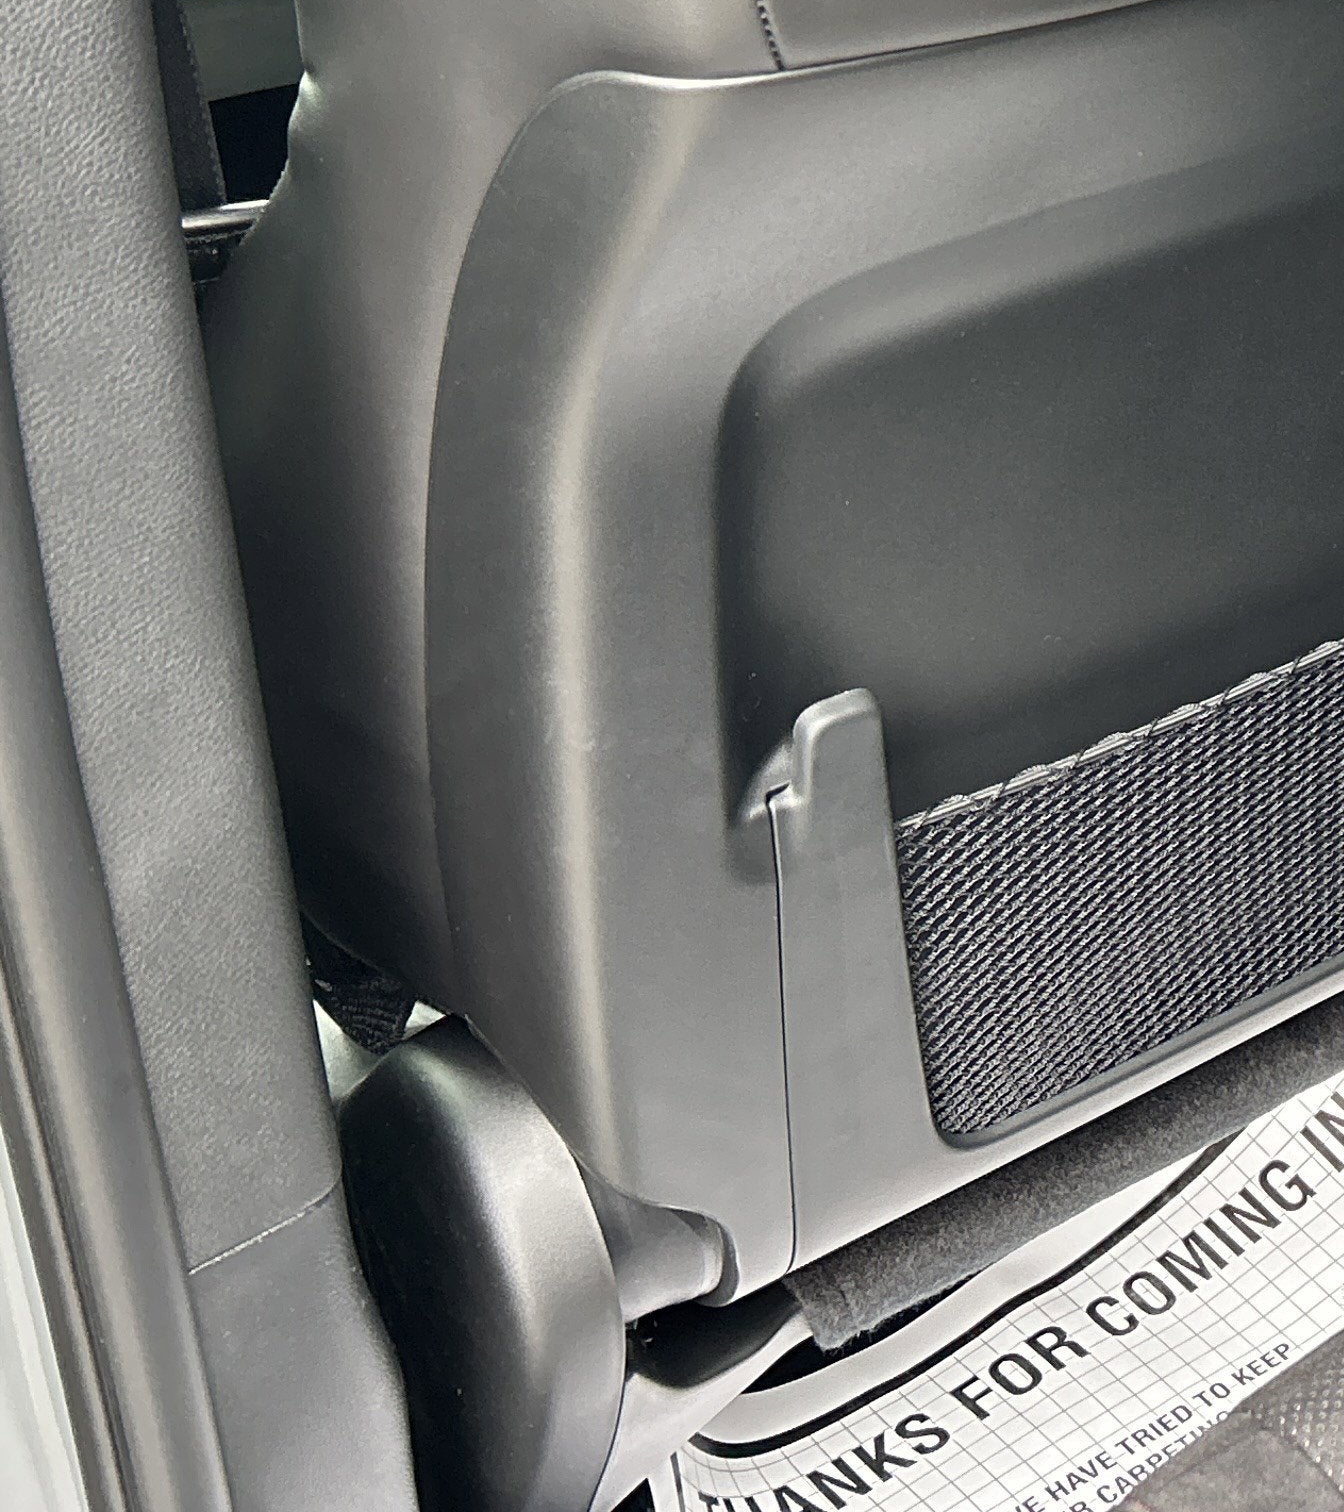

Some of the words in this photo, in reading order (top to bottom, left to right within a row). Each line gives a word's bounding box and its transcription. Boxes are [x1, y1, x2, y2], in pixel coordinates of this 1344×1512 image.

[950, 1326, 1091, 1420] FOR
[1085, 1159, 1317, 1336] COMING
[1044, 1450, 1118, 1501] HAVE
[1114, 1404, 1193, 1456] TRIED
[1192, 1382, 1231, 1408] TO
[1231, 1342, 1290, 1386] KEEP
